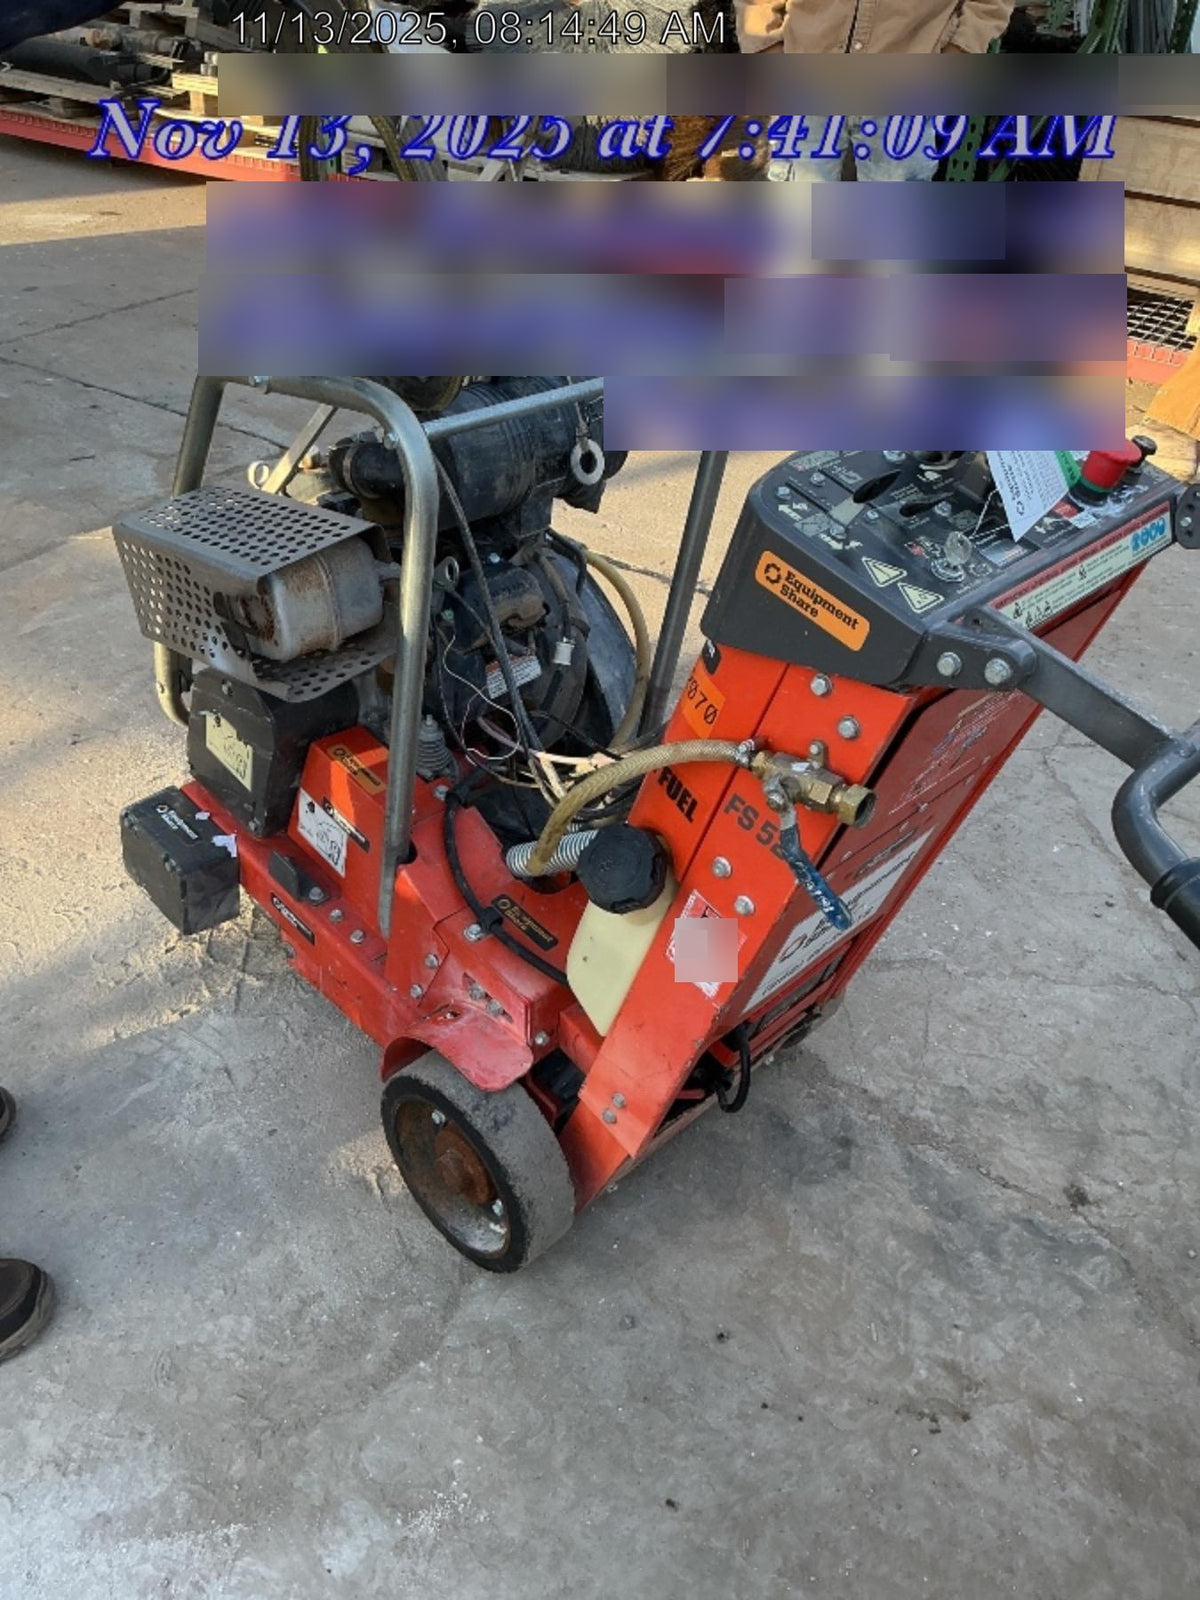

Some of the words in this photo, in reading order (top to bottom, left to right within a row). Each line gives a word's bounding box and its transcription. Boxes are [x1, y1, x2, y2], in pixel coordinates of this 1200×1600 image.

[779, 584, 820, 618] Share
[784, 569, 860, 631] Equipment
[658, 765, 698, 824] FUEL
[723, 793, 760, 832] FS
